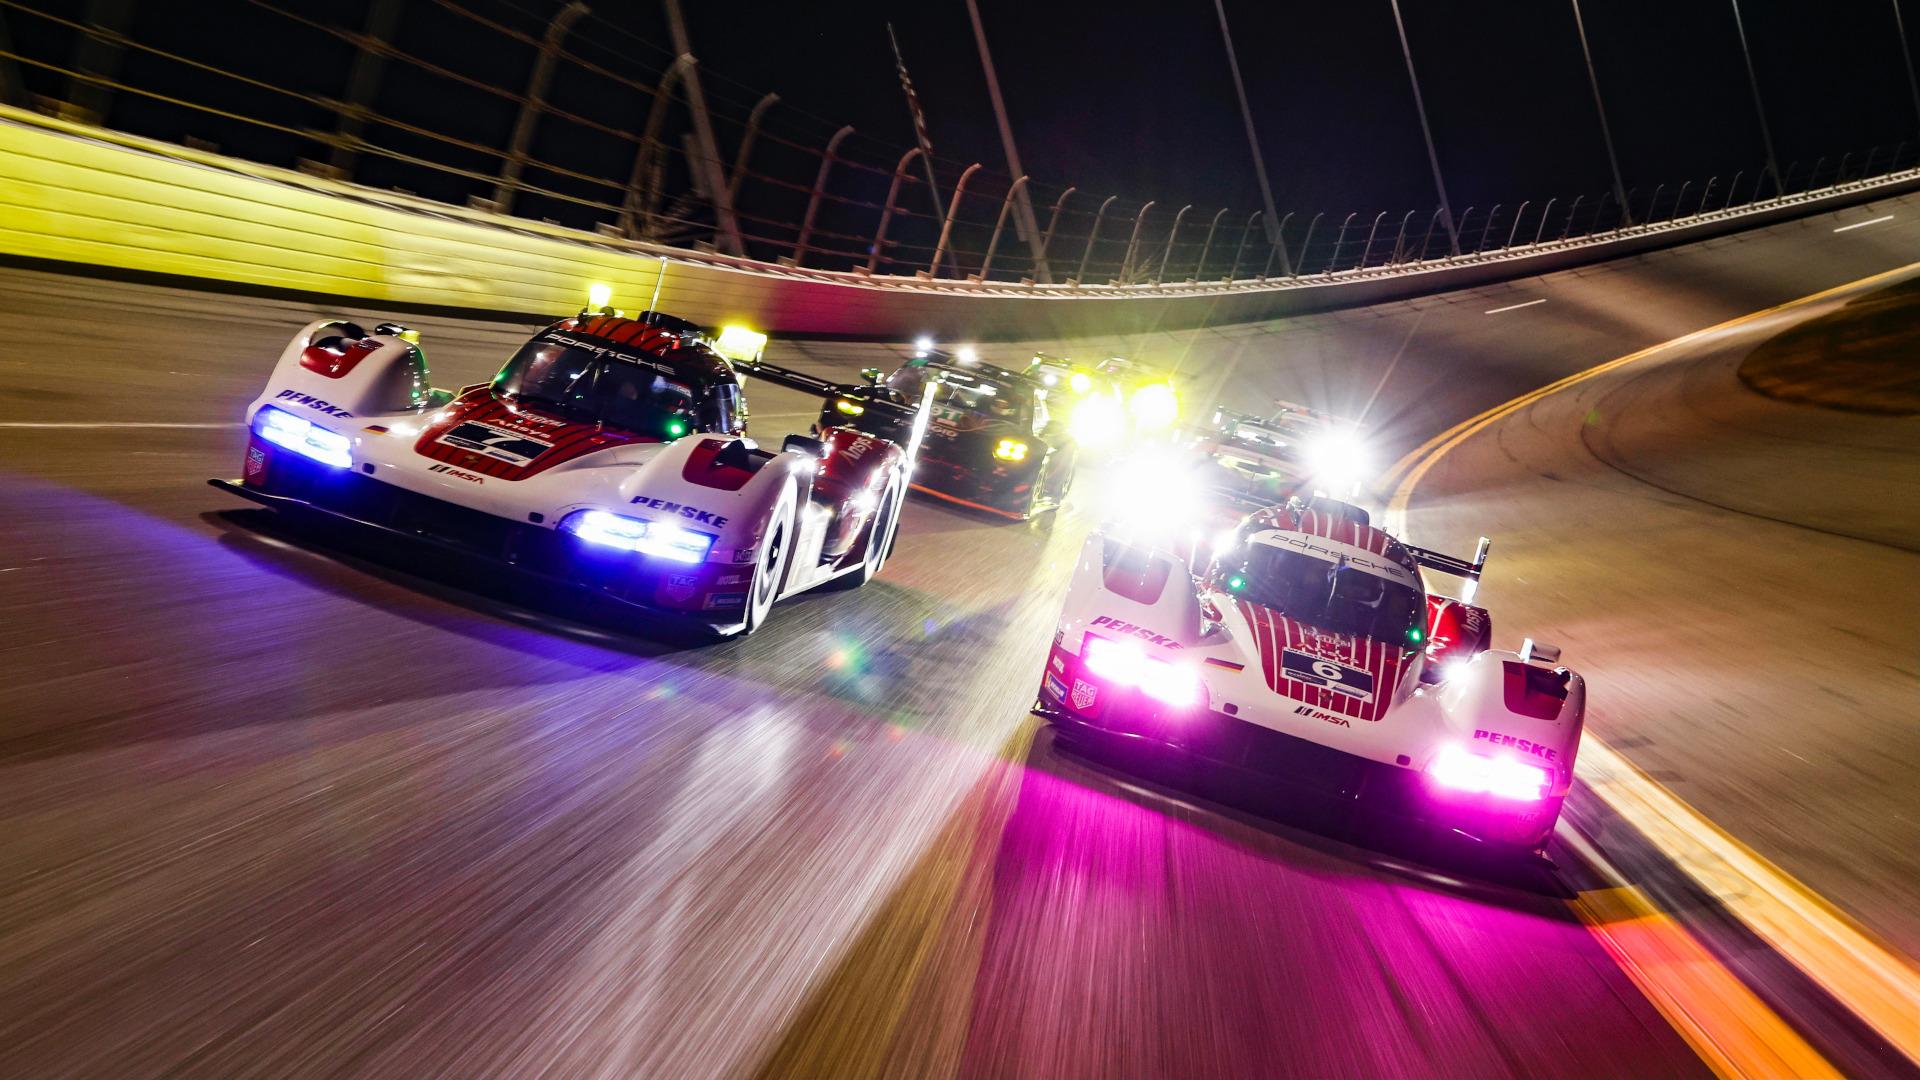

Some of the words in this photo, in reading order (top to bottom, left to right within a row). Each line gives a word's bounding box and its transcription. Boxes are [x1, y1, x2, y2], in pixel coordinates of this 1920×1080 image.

[544, 333, 676, 376] PORSCHE
[275, 389, 354, 419] PENSKE
[481, 429, 523, 445] 7
[488, 418, 552, 439] Ansys
[446, 469, 485, 485] IMSA
[631, 495, 729, 529] PENSKE
[1270, 533, 1405, 578] PORSCHE
[1090, 615, 1185, 650] PENSKE
[1312, 660, 1343, 681] 6
[1075, 680, 1096, 697] TAG
[1312, 711, 1351, 728] IMSA
[1473, 729, 1558, 762] PENSKE
